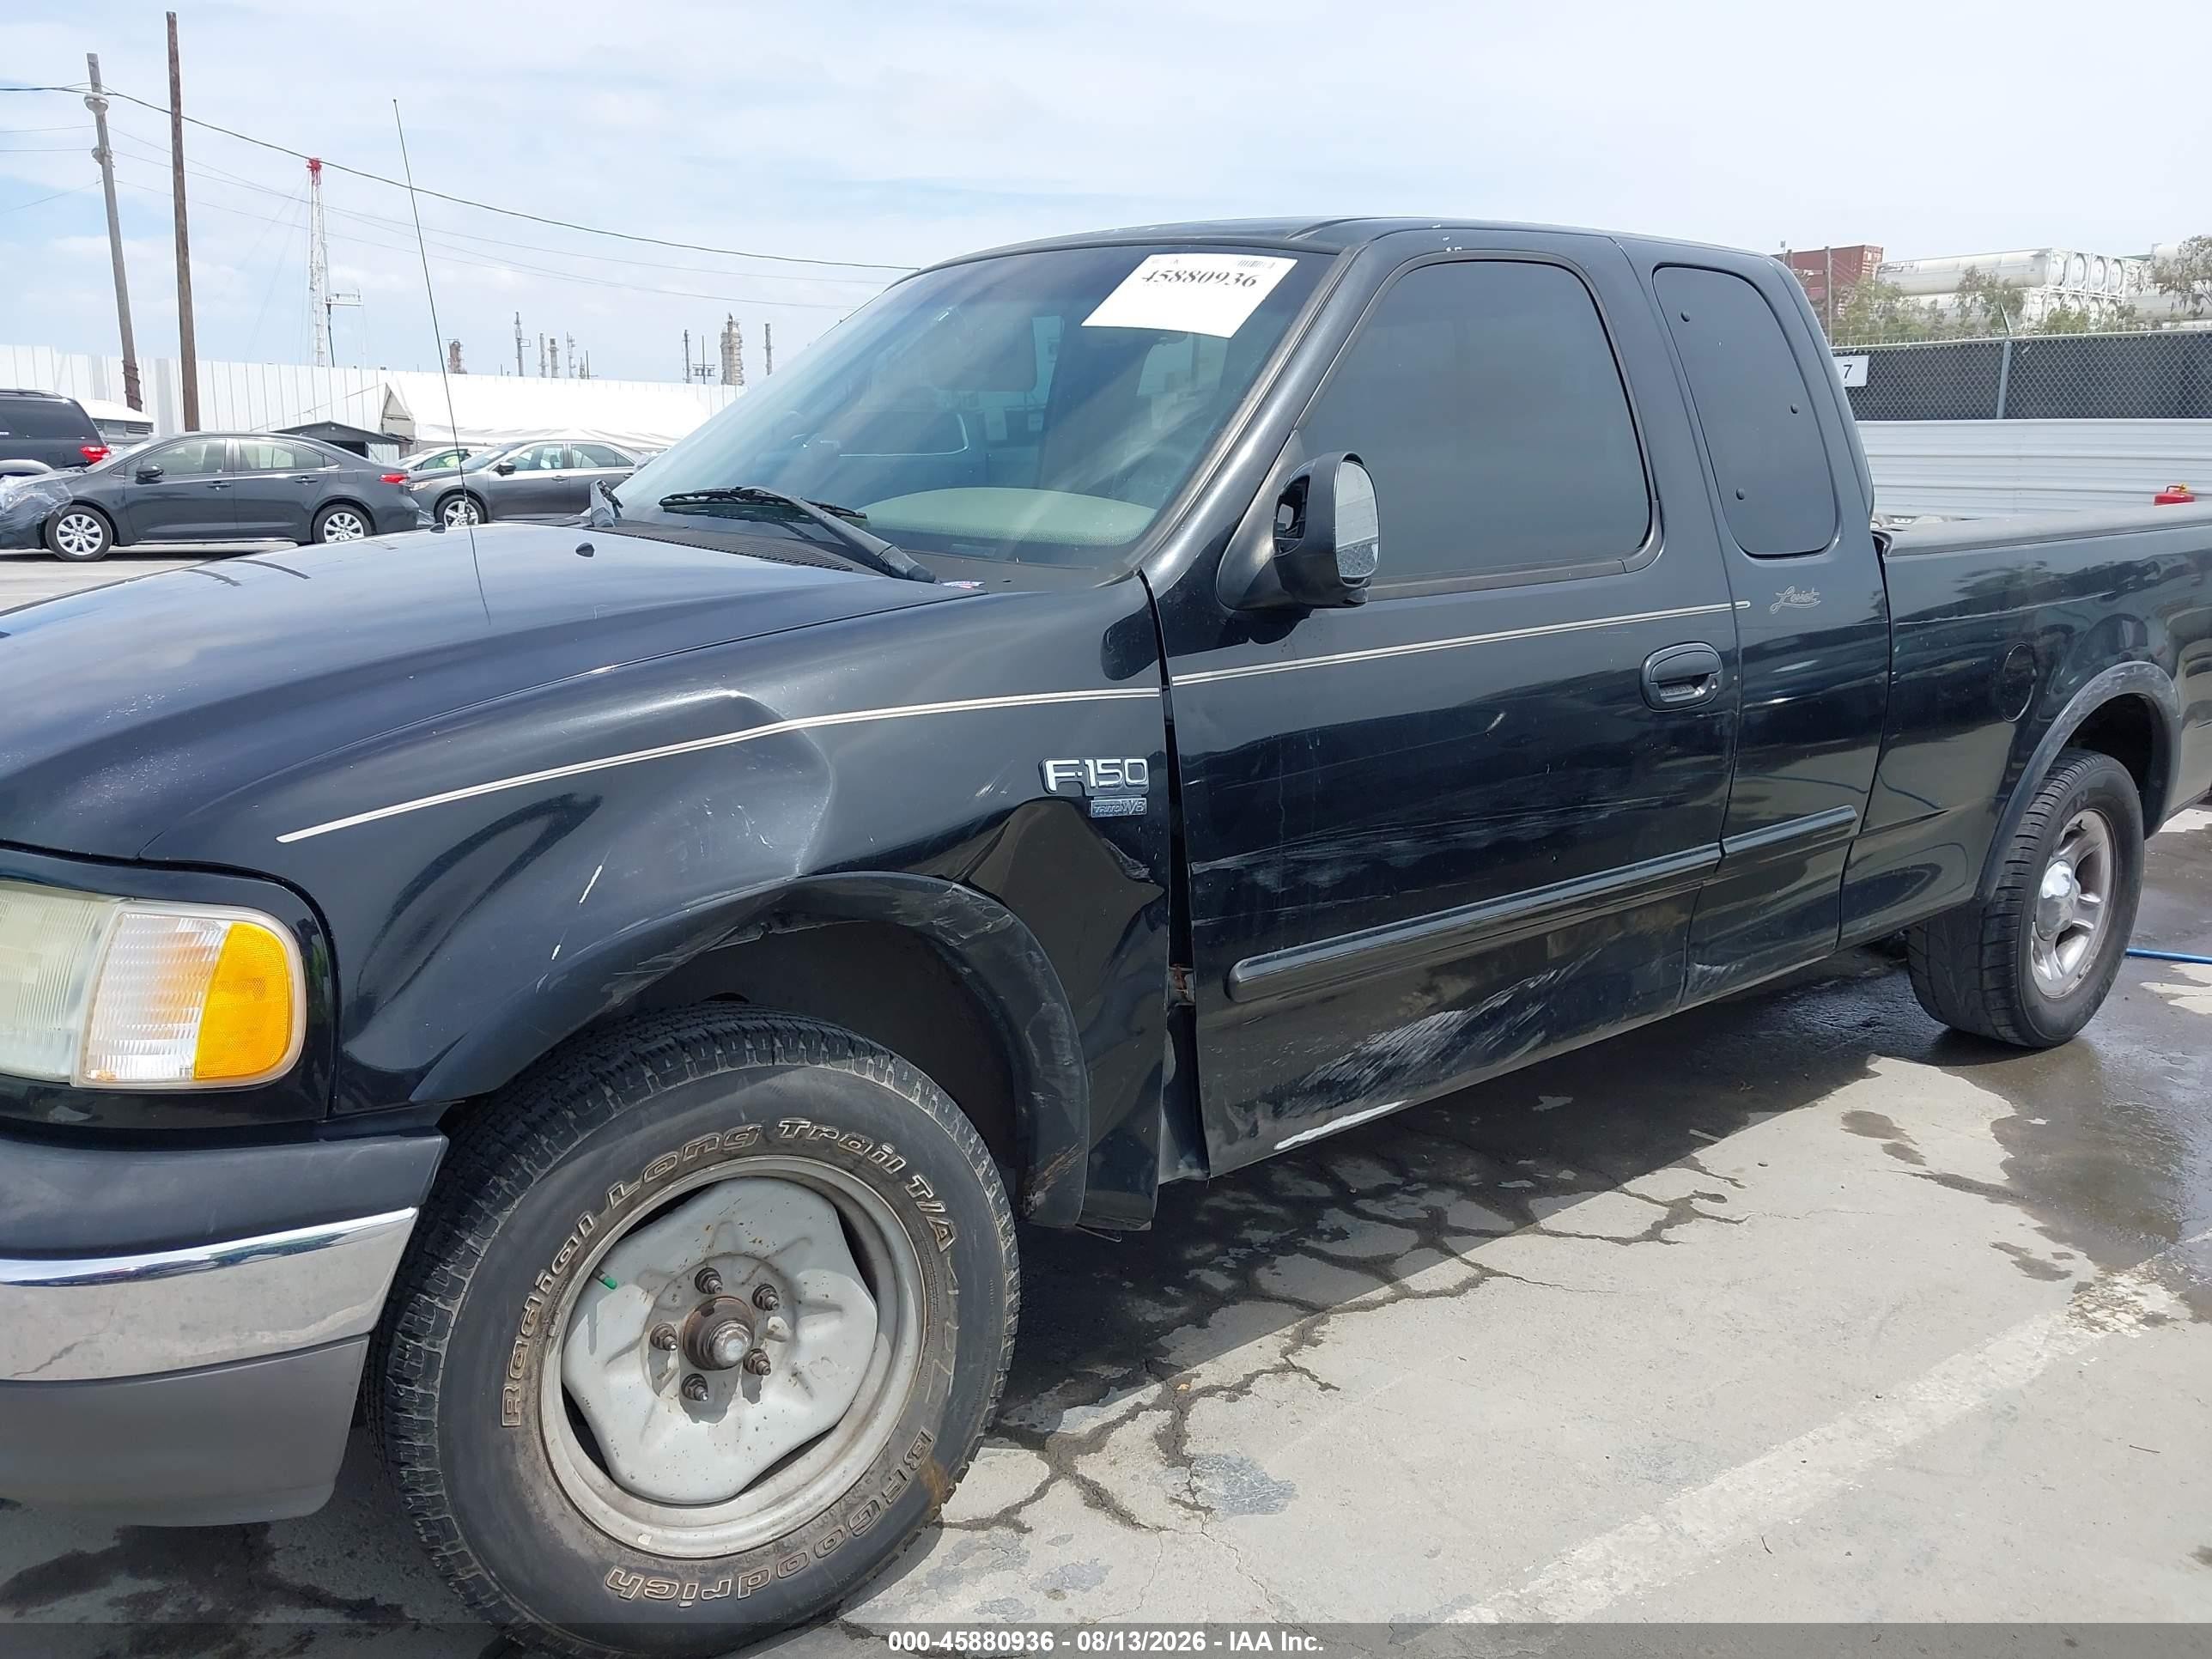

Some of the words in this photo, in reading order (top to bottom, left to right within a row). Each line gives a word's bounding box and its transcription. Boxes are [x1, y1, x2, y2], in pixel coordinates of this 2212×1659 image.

[1141, 270, 1261, 288] 45880936
[1843, 363, 1853, 380] 7
[1044, 757, 1149, 791] F-150
[501, 1212, 595, 1427] Radial
[605, 1124, 764, 1210] Long
[776, 1118, 908, 1175] Trail
[904, 1172, 958, 1254] T/A
[604, 1425, 936, 1609] BFGoodrich
